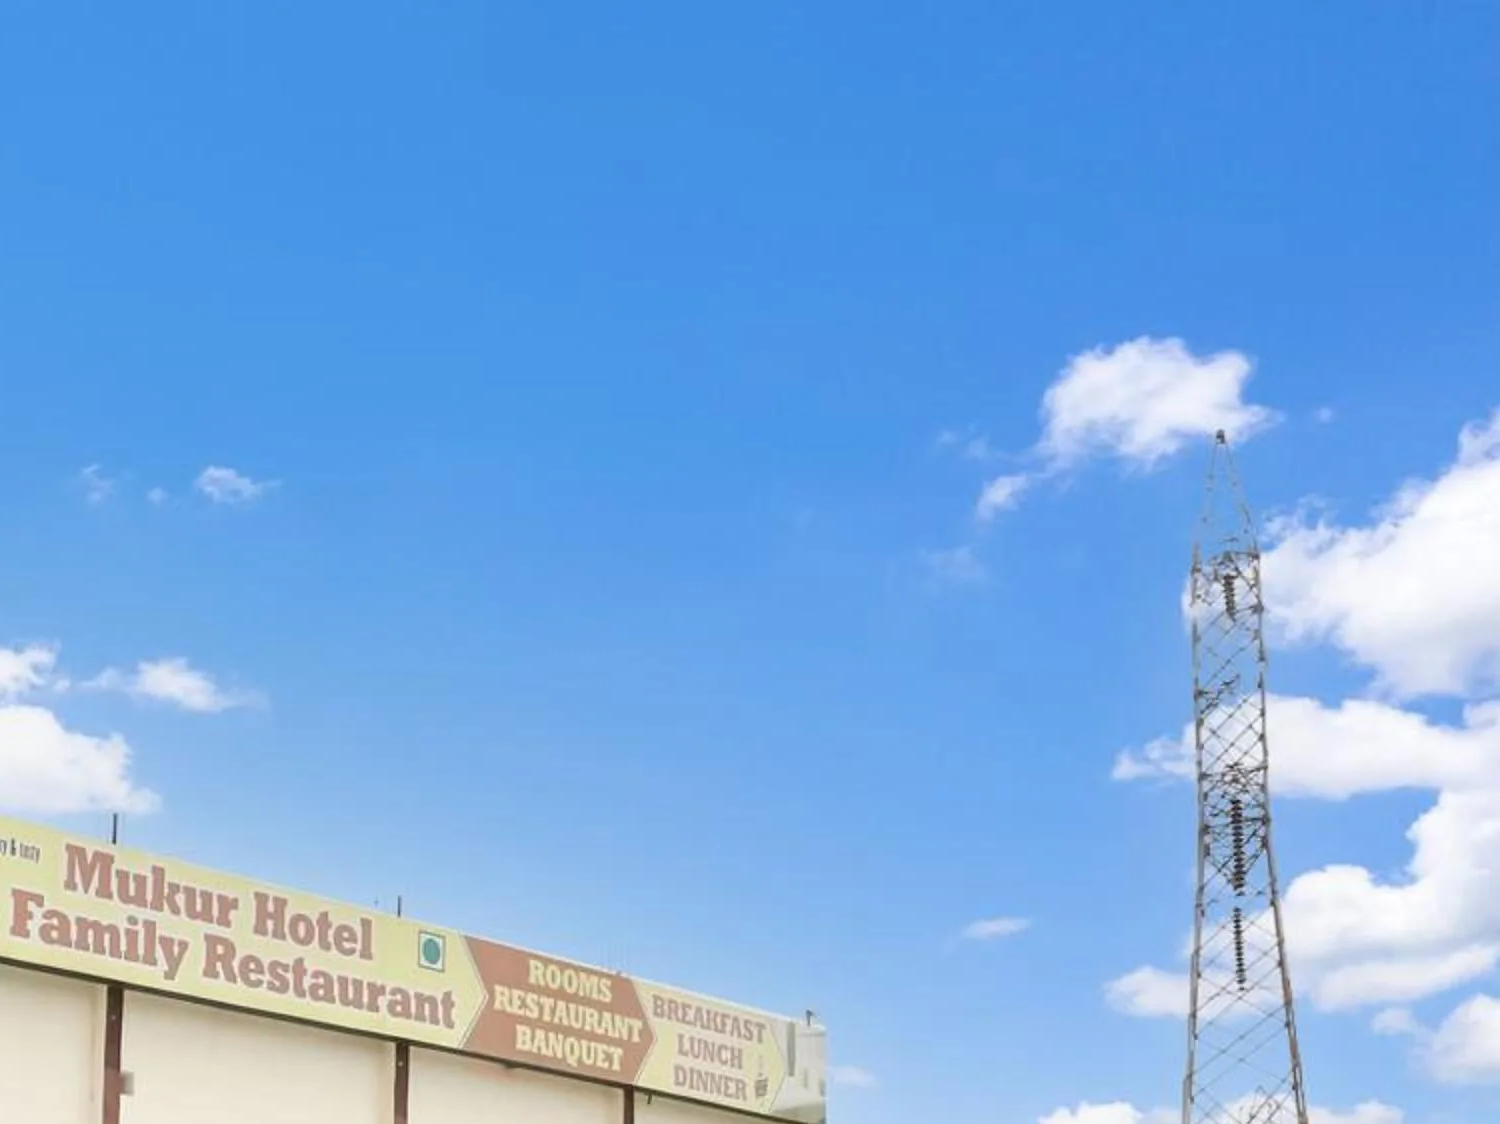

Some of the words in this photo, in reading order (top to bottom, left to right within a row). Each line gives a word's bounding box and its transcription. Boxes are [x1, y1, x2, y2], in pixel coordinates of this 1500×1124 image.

[64, 842, 239, 928] Mukur
[252, 891, 374, 961] Hotel
[9, 887, 188, 981] Family
[202, 933, 456, 1029] Restaurant
[528, 959, 612, 1003] ROOMS
[493, 985, 643, 1043] RESTAURANT
[652, 994, 767, 1045] BREAKFAST
[515, 1024, 623, 1072] BANQUET
[677, 1033, 743, 1069] LUNCH
[673, 1065, 747, 1101] DINNER
